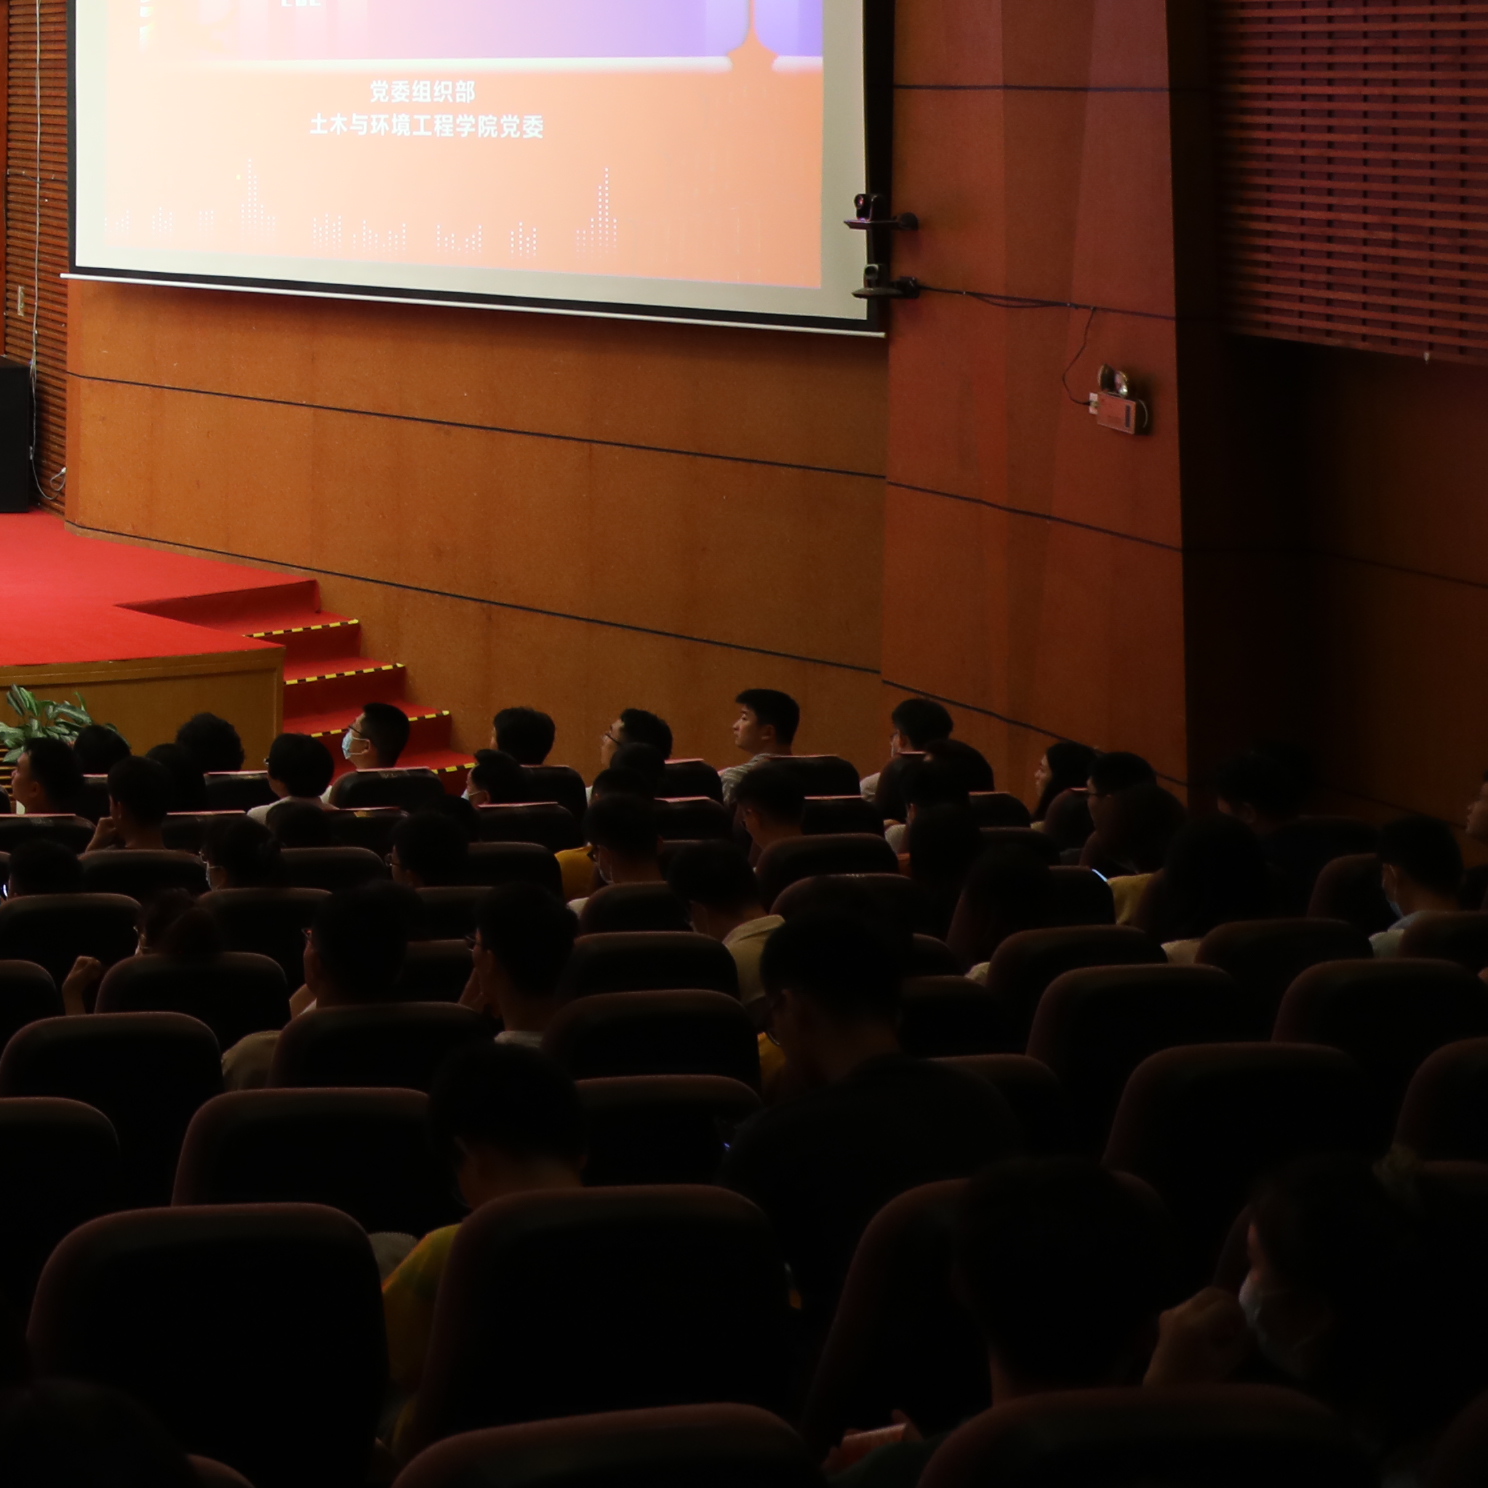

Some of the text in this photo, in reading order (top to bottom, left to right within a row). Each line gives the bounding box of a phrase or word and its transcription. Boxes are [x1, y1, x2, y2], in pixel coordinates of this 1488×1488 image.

[370, 80, 476, 103] 党委组织部
[310, 112, 544, 139] 土木与环境工程学院党委
